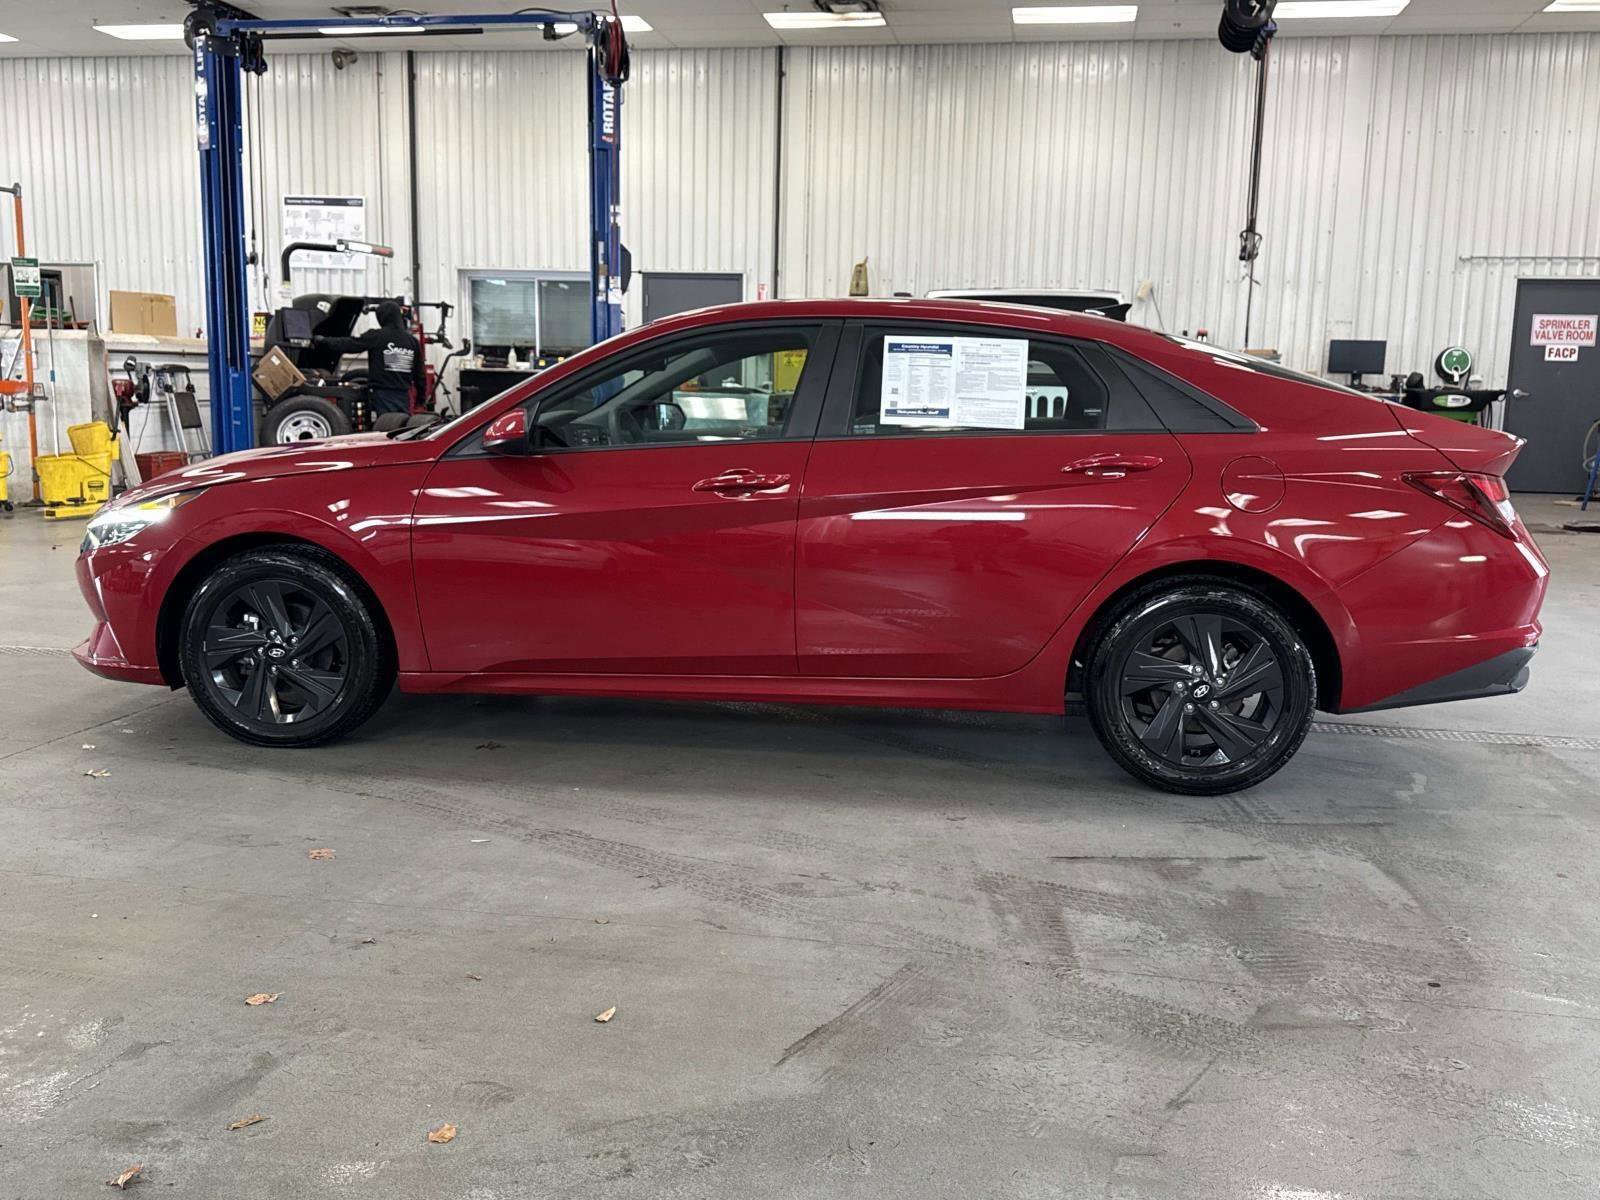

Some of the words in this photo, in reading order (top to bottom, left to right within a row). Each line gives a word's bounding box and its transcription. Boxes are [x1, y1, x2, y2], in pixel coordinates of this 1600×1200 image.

[196, 40, 204, 71] LIFT
[197, 76, 208, 136] ROTARY
[602, 79, 615, 133] ROTAR
[1539, 319, 1590, 329] SPRINKLER
[1535, 330, 1564, 340] VALVE
[1566, 330, 1593, 341] ROOM
[1547, 347, 1577, 358] FACP
